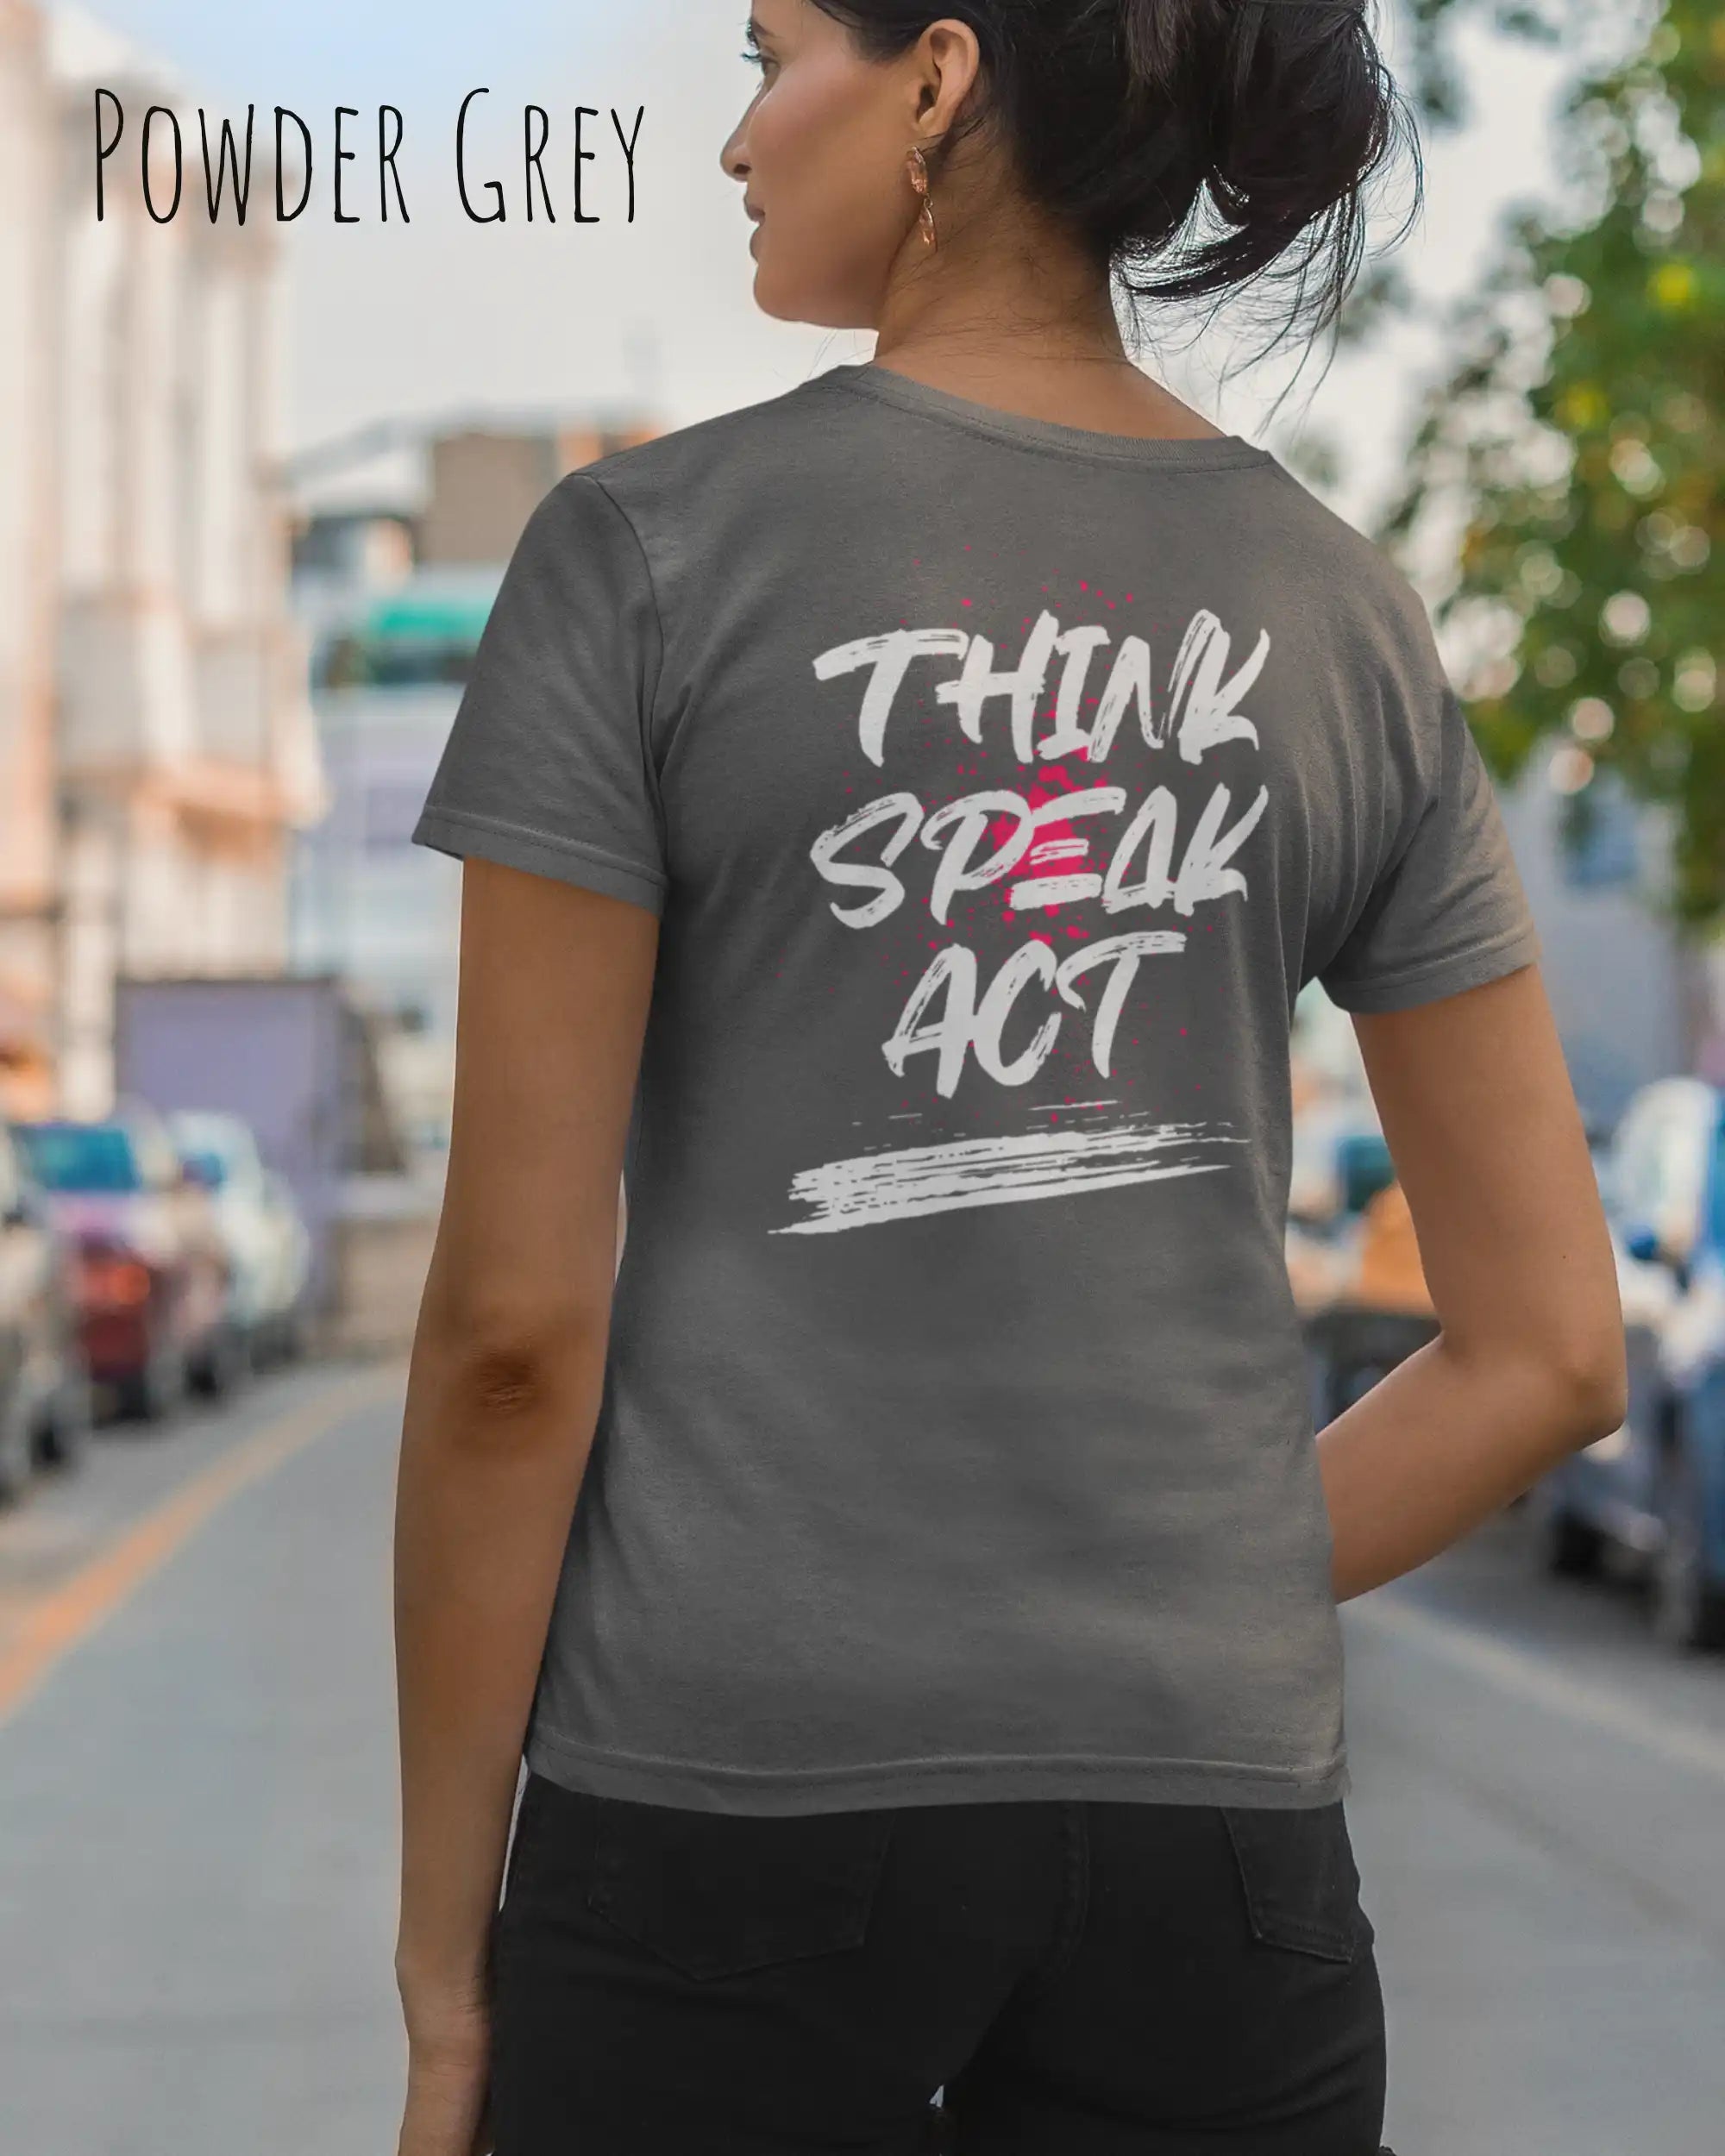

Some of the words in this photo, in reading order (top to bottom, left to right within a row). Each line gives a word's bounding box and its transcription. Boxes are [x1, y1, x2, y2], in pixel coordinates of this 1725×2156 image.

[812, 608, 1270, 768] THINK
[810, 782, 1269, 929] SPEAK
[881, 931, 1187, 1099] ACT
